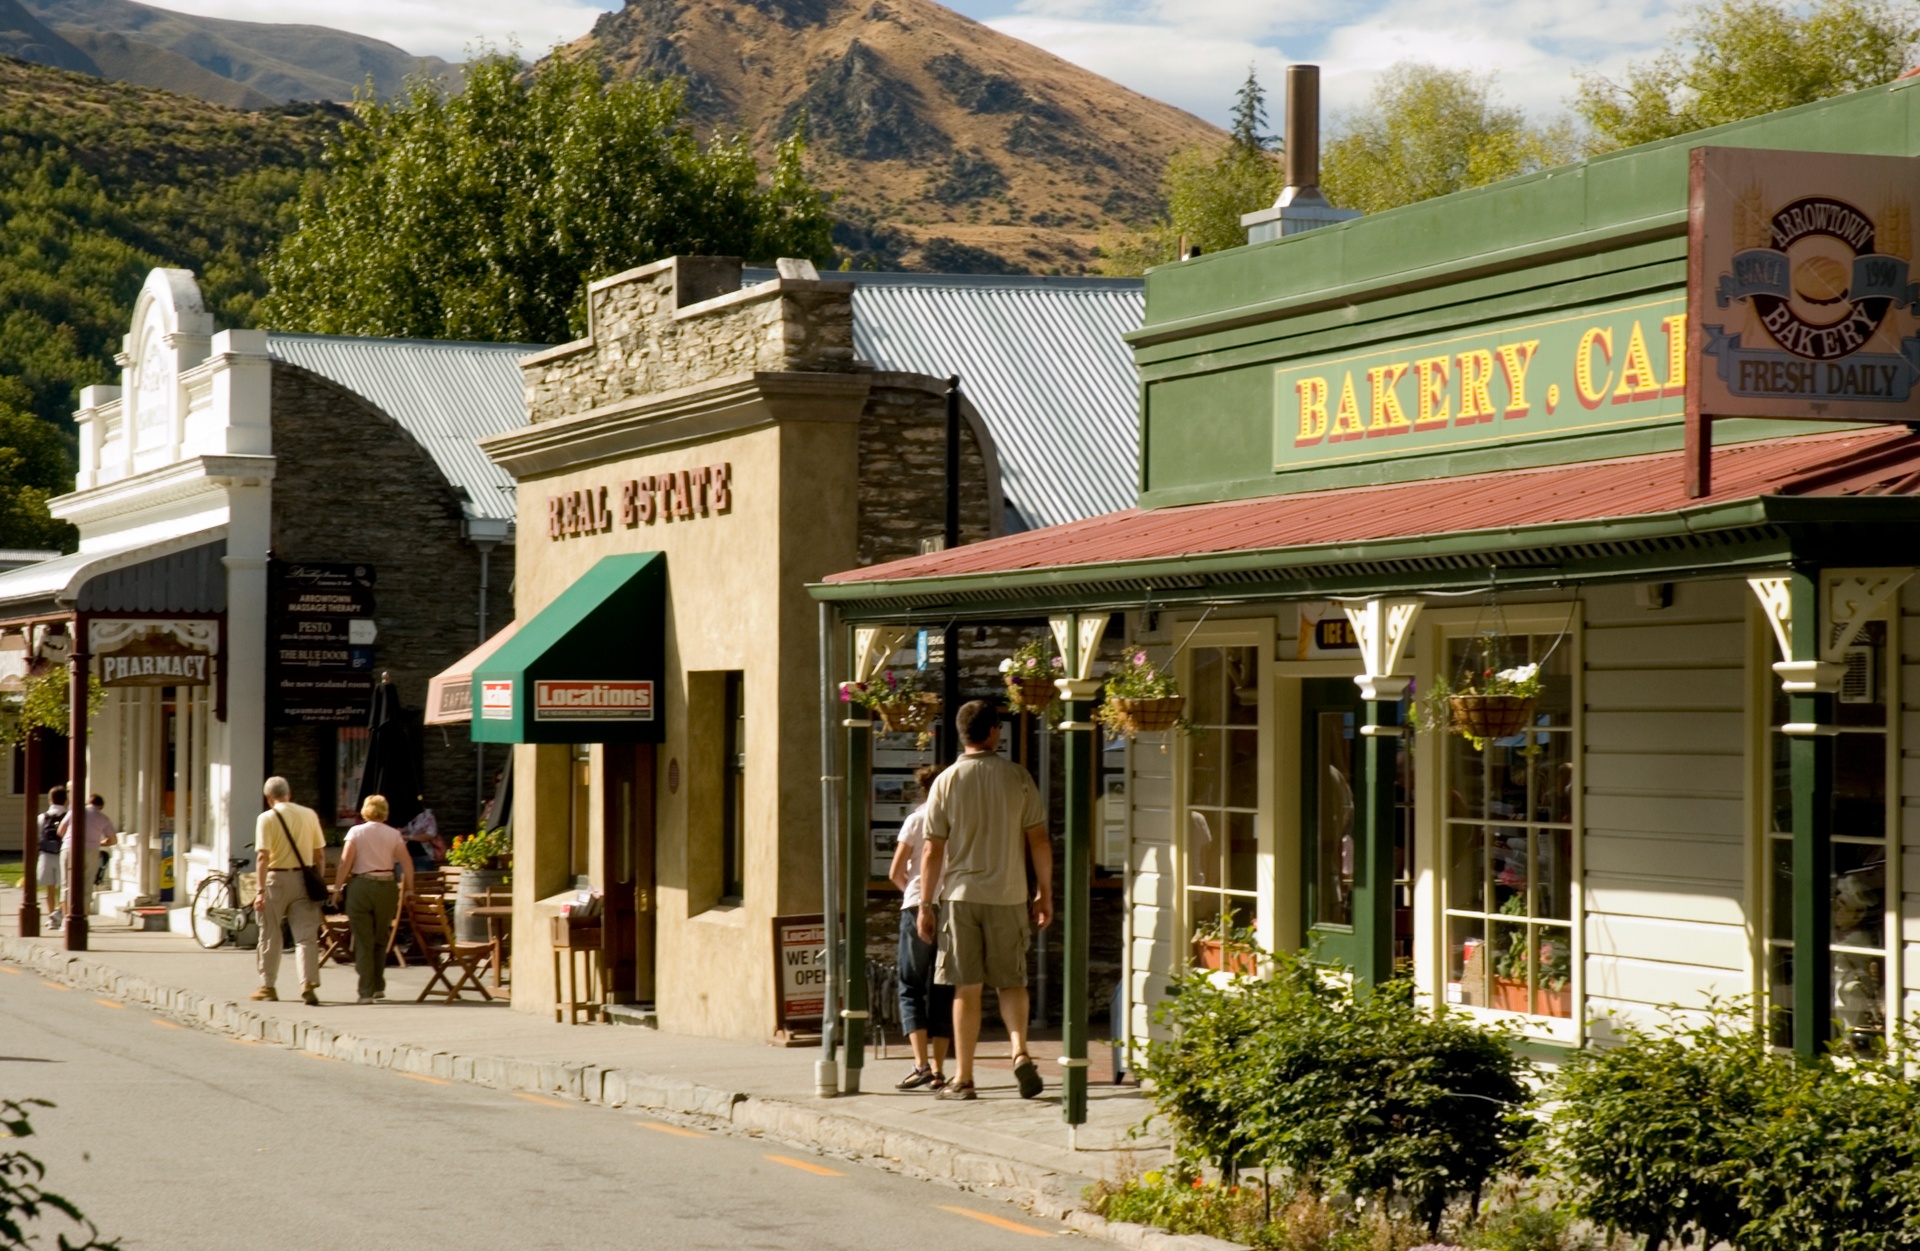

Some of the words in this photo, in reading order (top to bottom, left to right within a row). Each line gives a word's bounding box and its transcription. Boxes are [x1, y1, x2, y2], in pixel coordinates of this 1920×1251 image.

[1769, 203, 1875, 249] ARROWTOWN
[1735, 260, 1782, 287] SINCE
[1865, 261, 1897, 288] 1990
[1762, 303, 1877, 357] BAKERY
[1739, 360, 1816, 394] FRESH
[1827, 363, 1898, 396] DAILY
[547, 486, 609, 539] REAL
[620, 462, 729, 525] ESTATE
[288, 603, 327, 612] MASSAGE
[328, 604, 361, 613] THERAPY
[298, 621, 332, 633] PESTO
[1323, 622, 1342, 645] ICE
[279, 650, 298, 659] THE
[322, 650, 349, 660] DOOR
[103, 655, 206, 683] PHARMACY
[539, 685, 650, 707] Locations
[786, 950, 809, 966] WE
[795, 970, 825, 985] OPE
